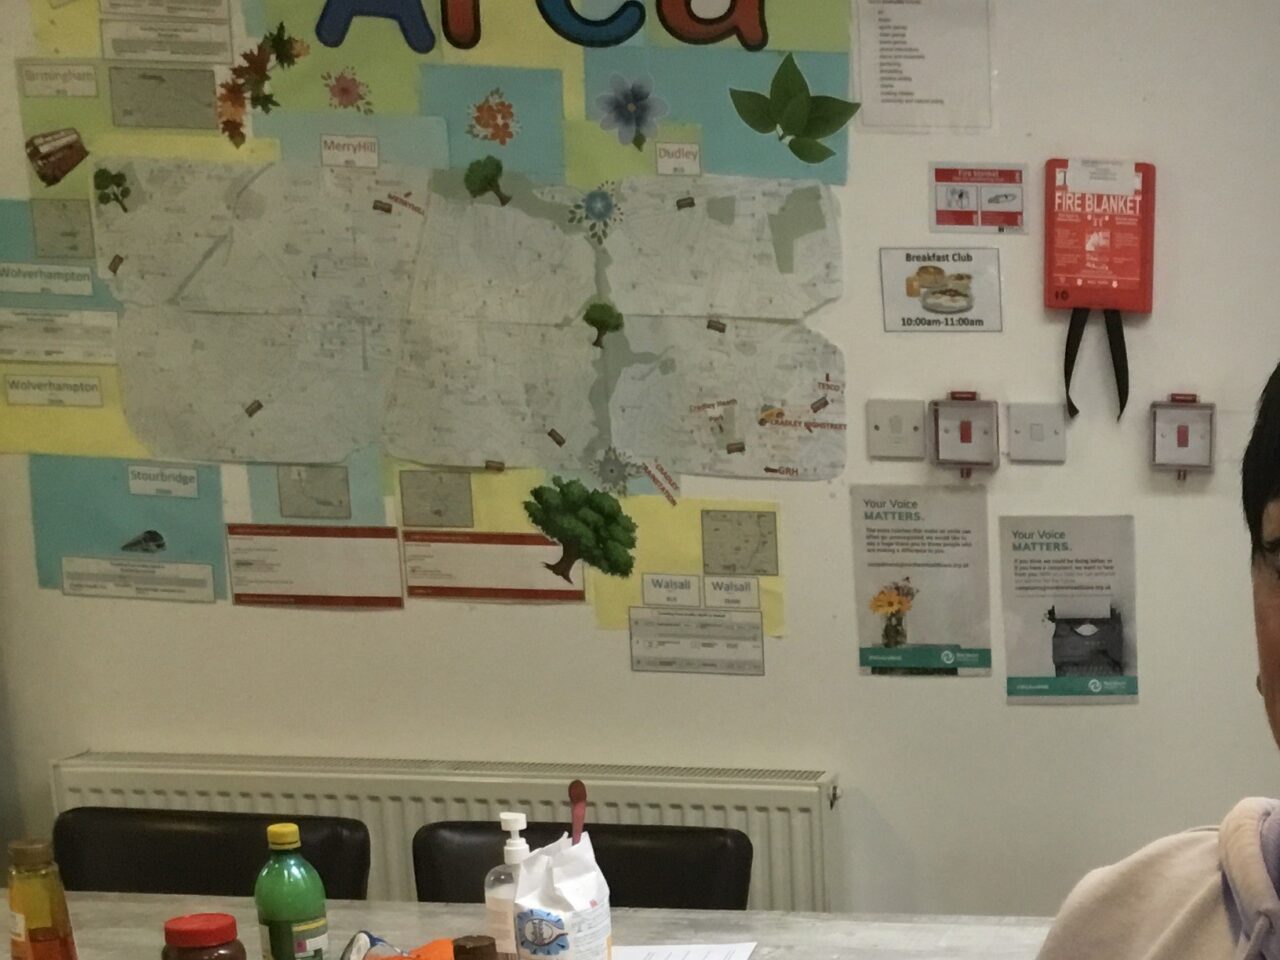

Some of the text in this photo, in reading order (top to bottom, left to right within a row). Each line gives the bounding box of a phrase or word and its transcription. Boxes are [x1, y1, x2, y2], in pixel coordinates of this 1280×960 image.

[658, 147, 698, 162] Dudley
[1055, 192, 1142, 216] FIRE BLANKET
[905, 253, 974, 262] Breakfast Club
[901, 317, 984, 327] 10:00am-11:00am
[8, 379, 99, 394] Wolverhampton
[778, 465, 800, 476] GRH
[130, 469, 196, 486] Stourbridge
[864, 499, 918, 509] Your Voice
[864, 511, 925, 521] MATTERS.
[1012, 530, 1067, 540] Your Voice
[1012, 542, 1073, 551] MATTERS.
[651, 579, 692, 590] Walsall
[711, 582, 752, 592] Walsall
